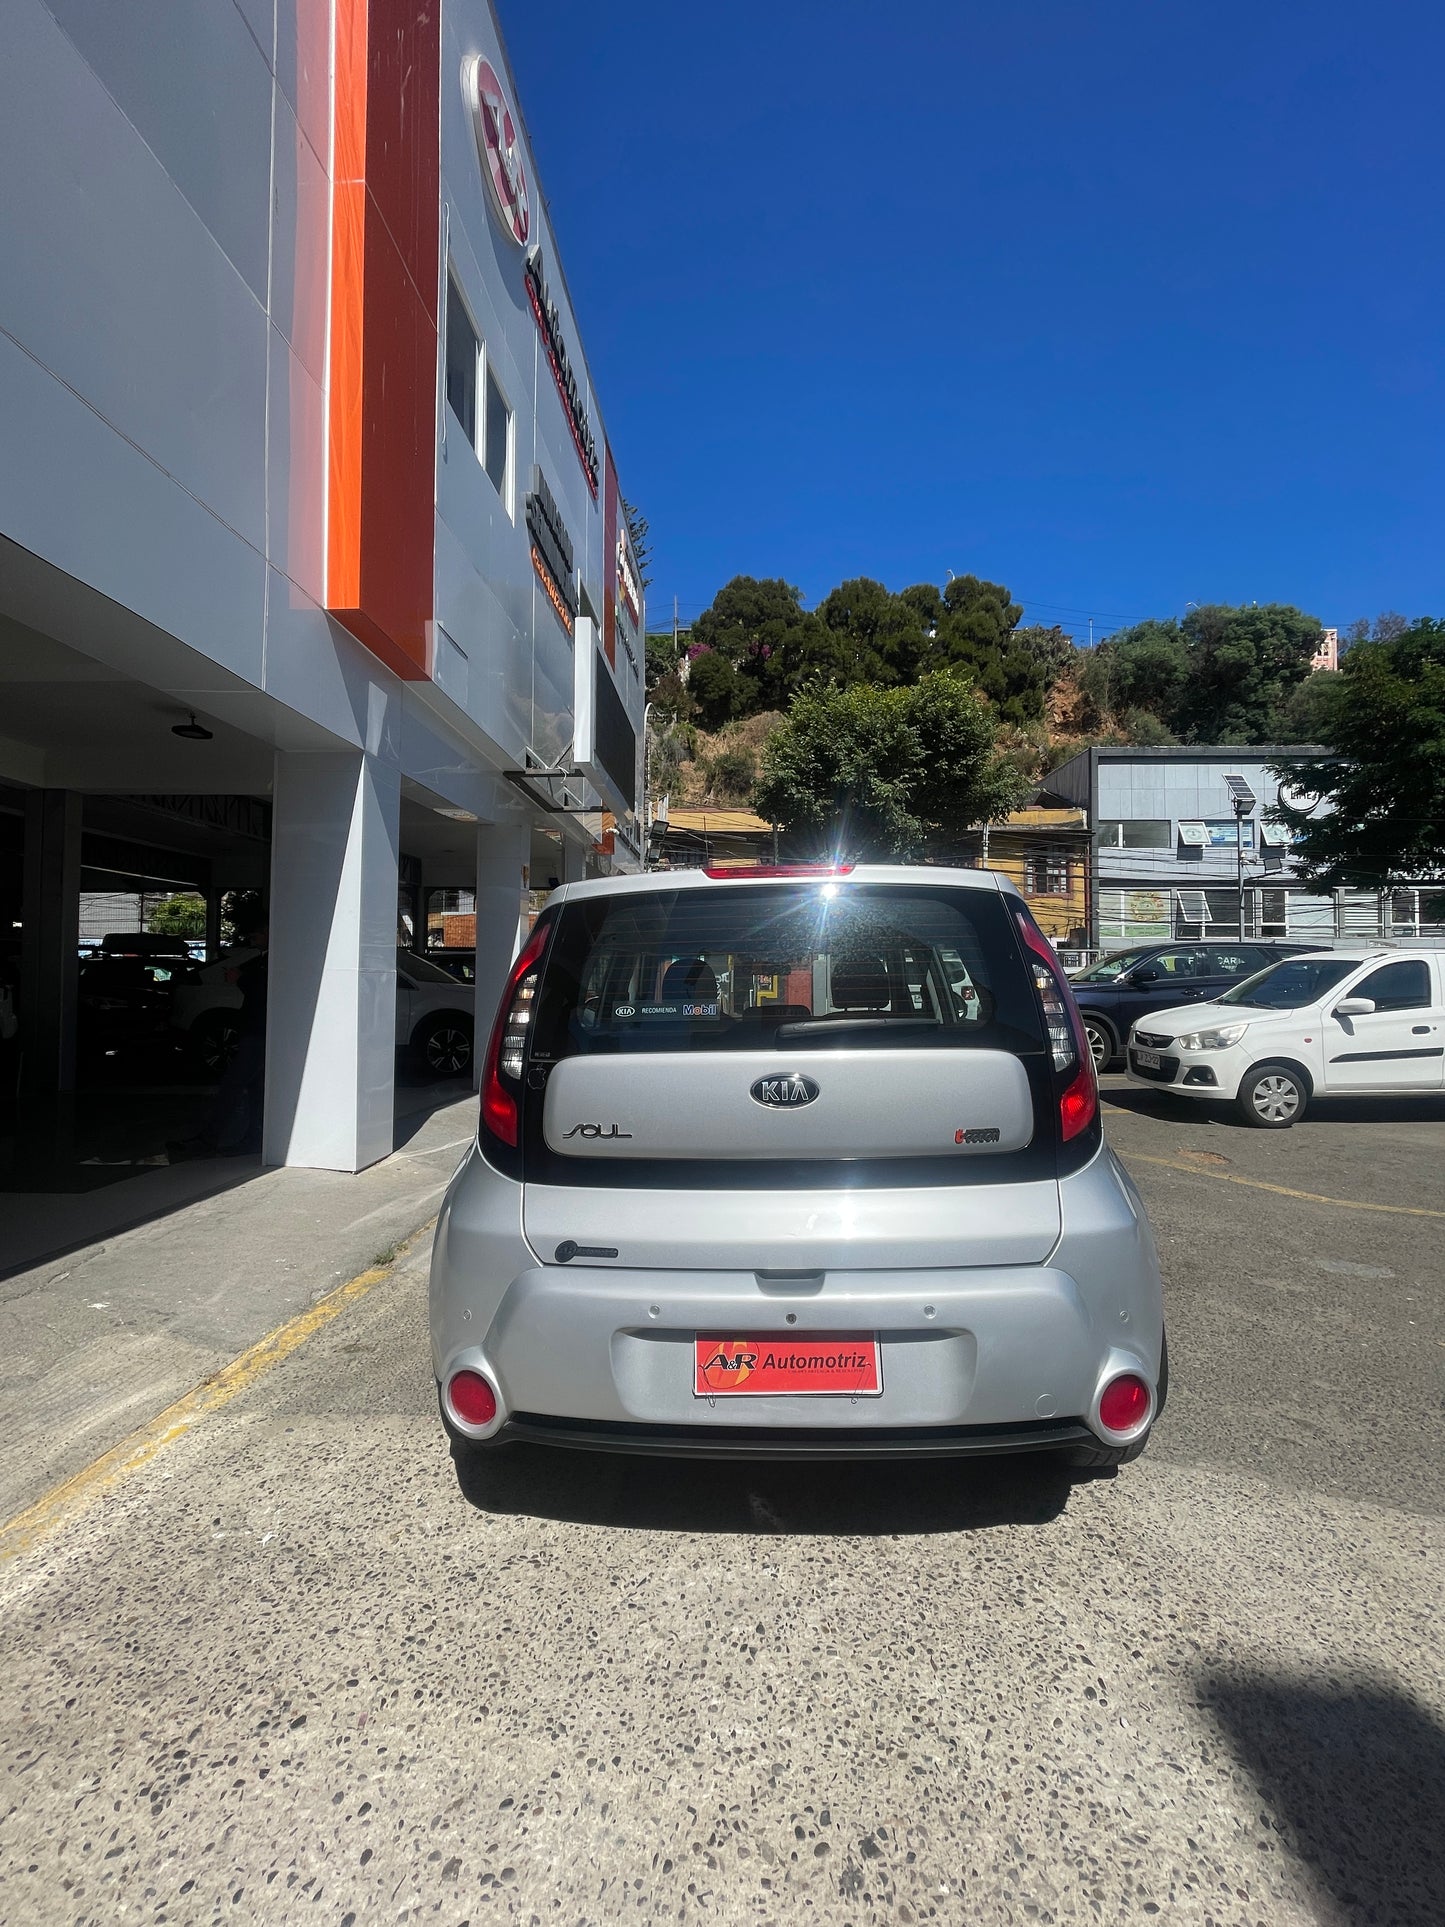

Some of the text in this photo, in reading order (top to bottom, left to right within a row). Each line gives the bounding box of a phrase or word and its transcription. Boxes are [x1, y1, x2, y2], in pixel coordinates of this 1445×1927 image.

[616, 1004, 717, 1016] KIA RECOMIENDA Mobil
[761, 1080, 809, 1101] KIA
[562, 1123, 633, 1139] SOUL
[704, 1351, 867, 1370] A&R Automotriz
